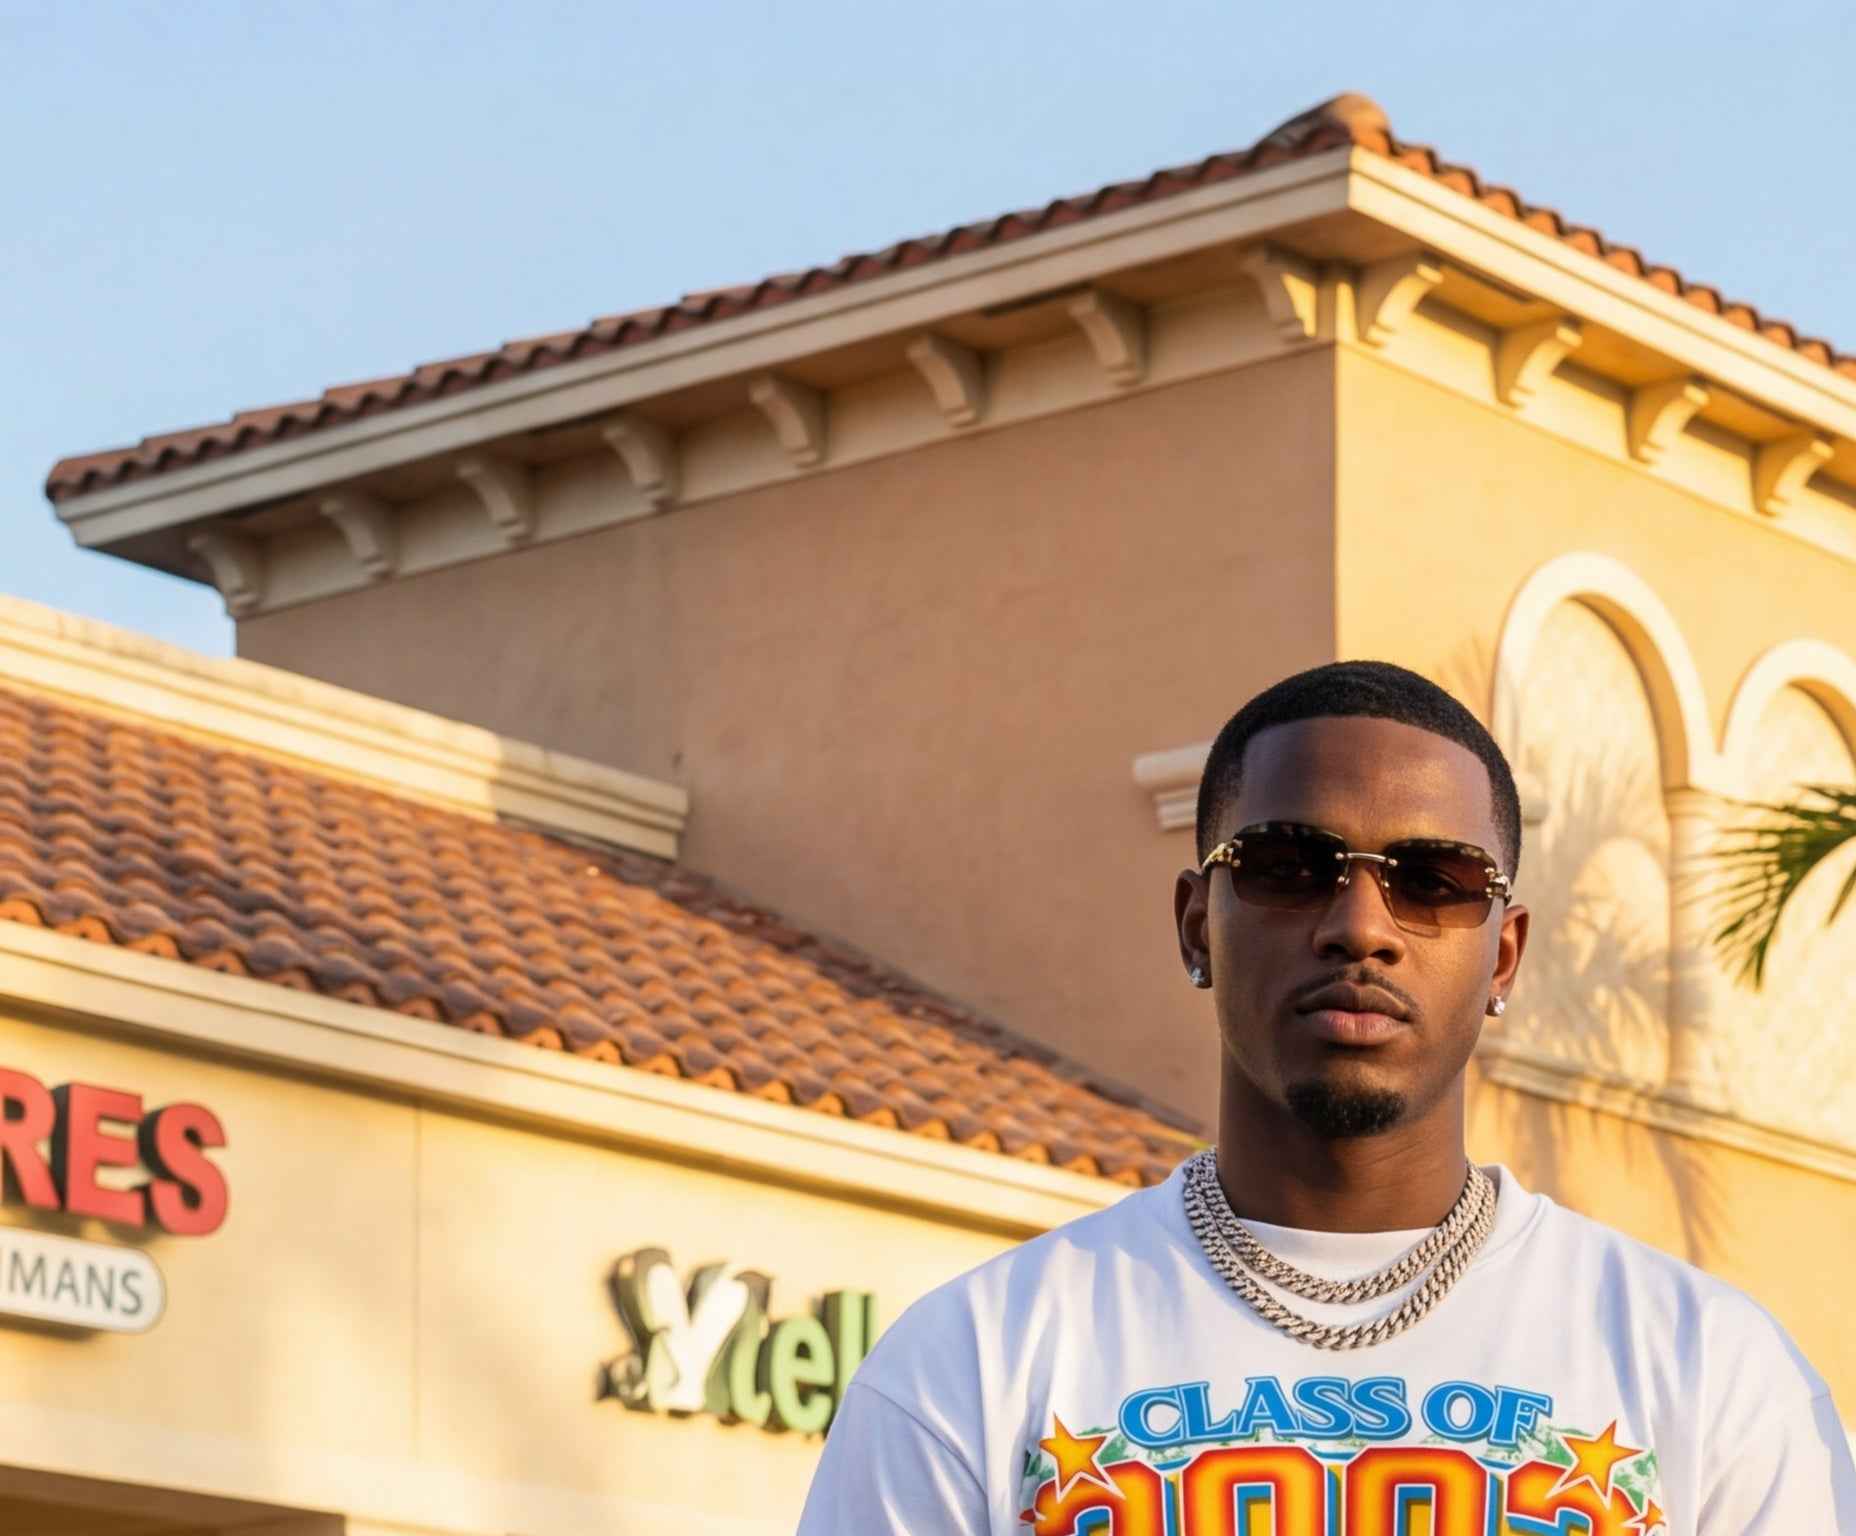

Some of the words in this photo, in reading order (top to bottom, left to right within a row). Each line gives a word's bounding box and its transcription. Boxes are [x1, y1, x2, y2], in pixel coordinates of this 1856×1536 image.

[8, 1249, 143, 1316] MANS
[1118, 1376, 1412, 1447] CLASS
[1421, 1381, 1553, 1447] OF
